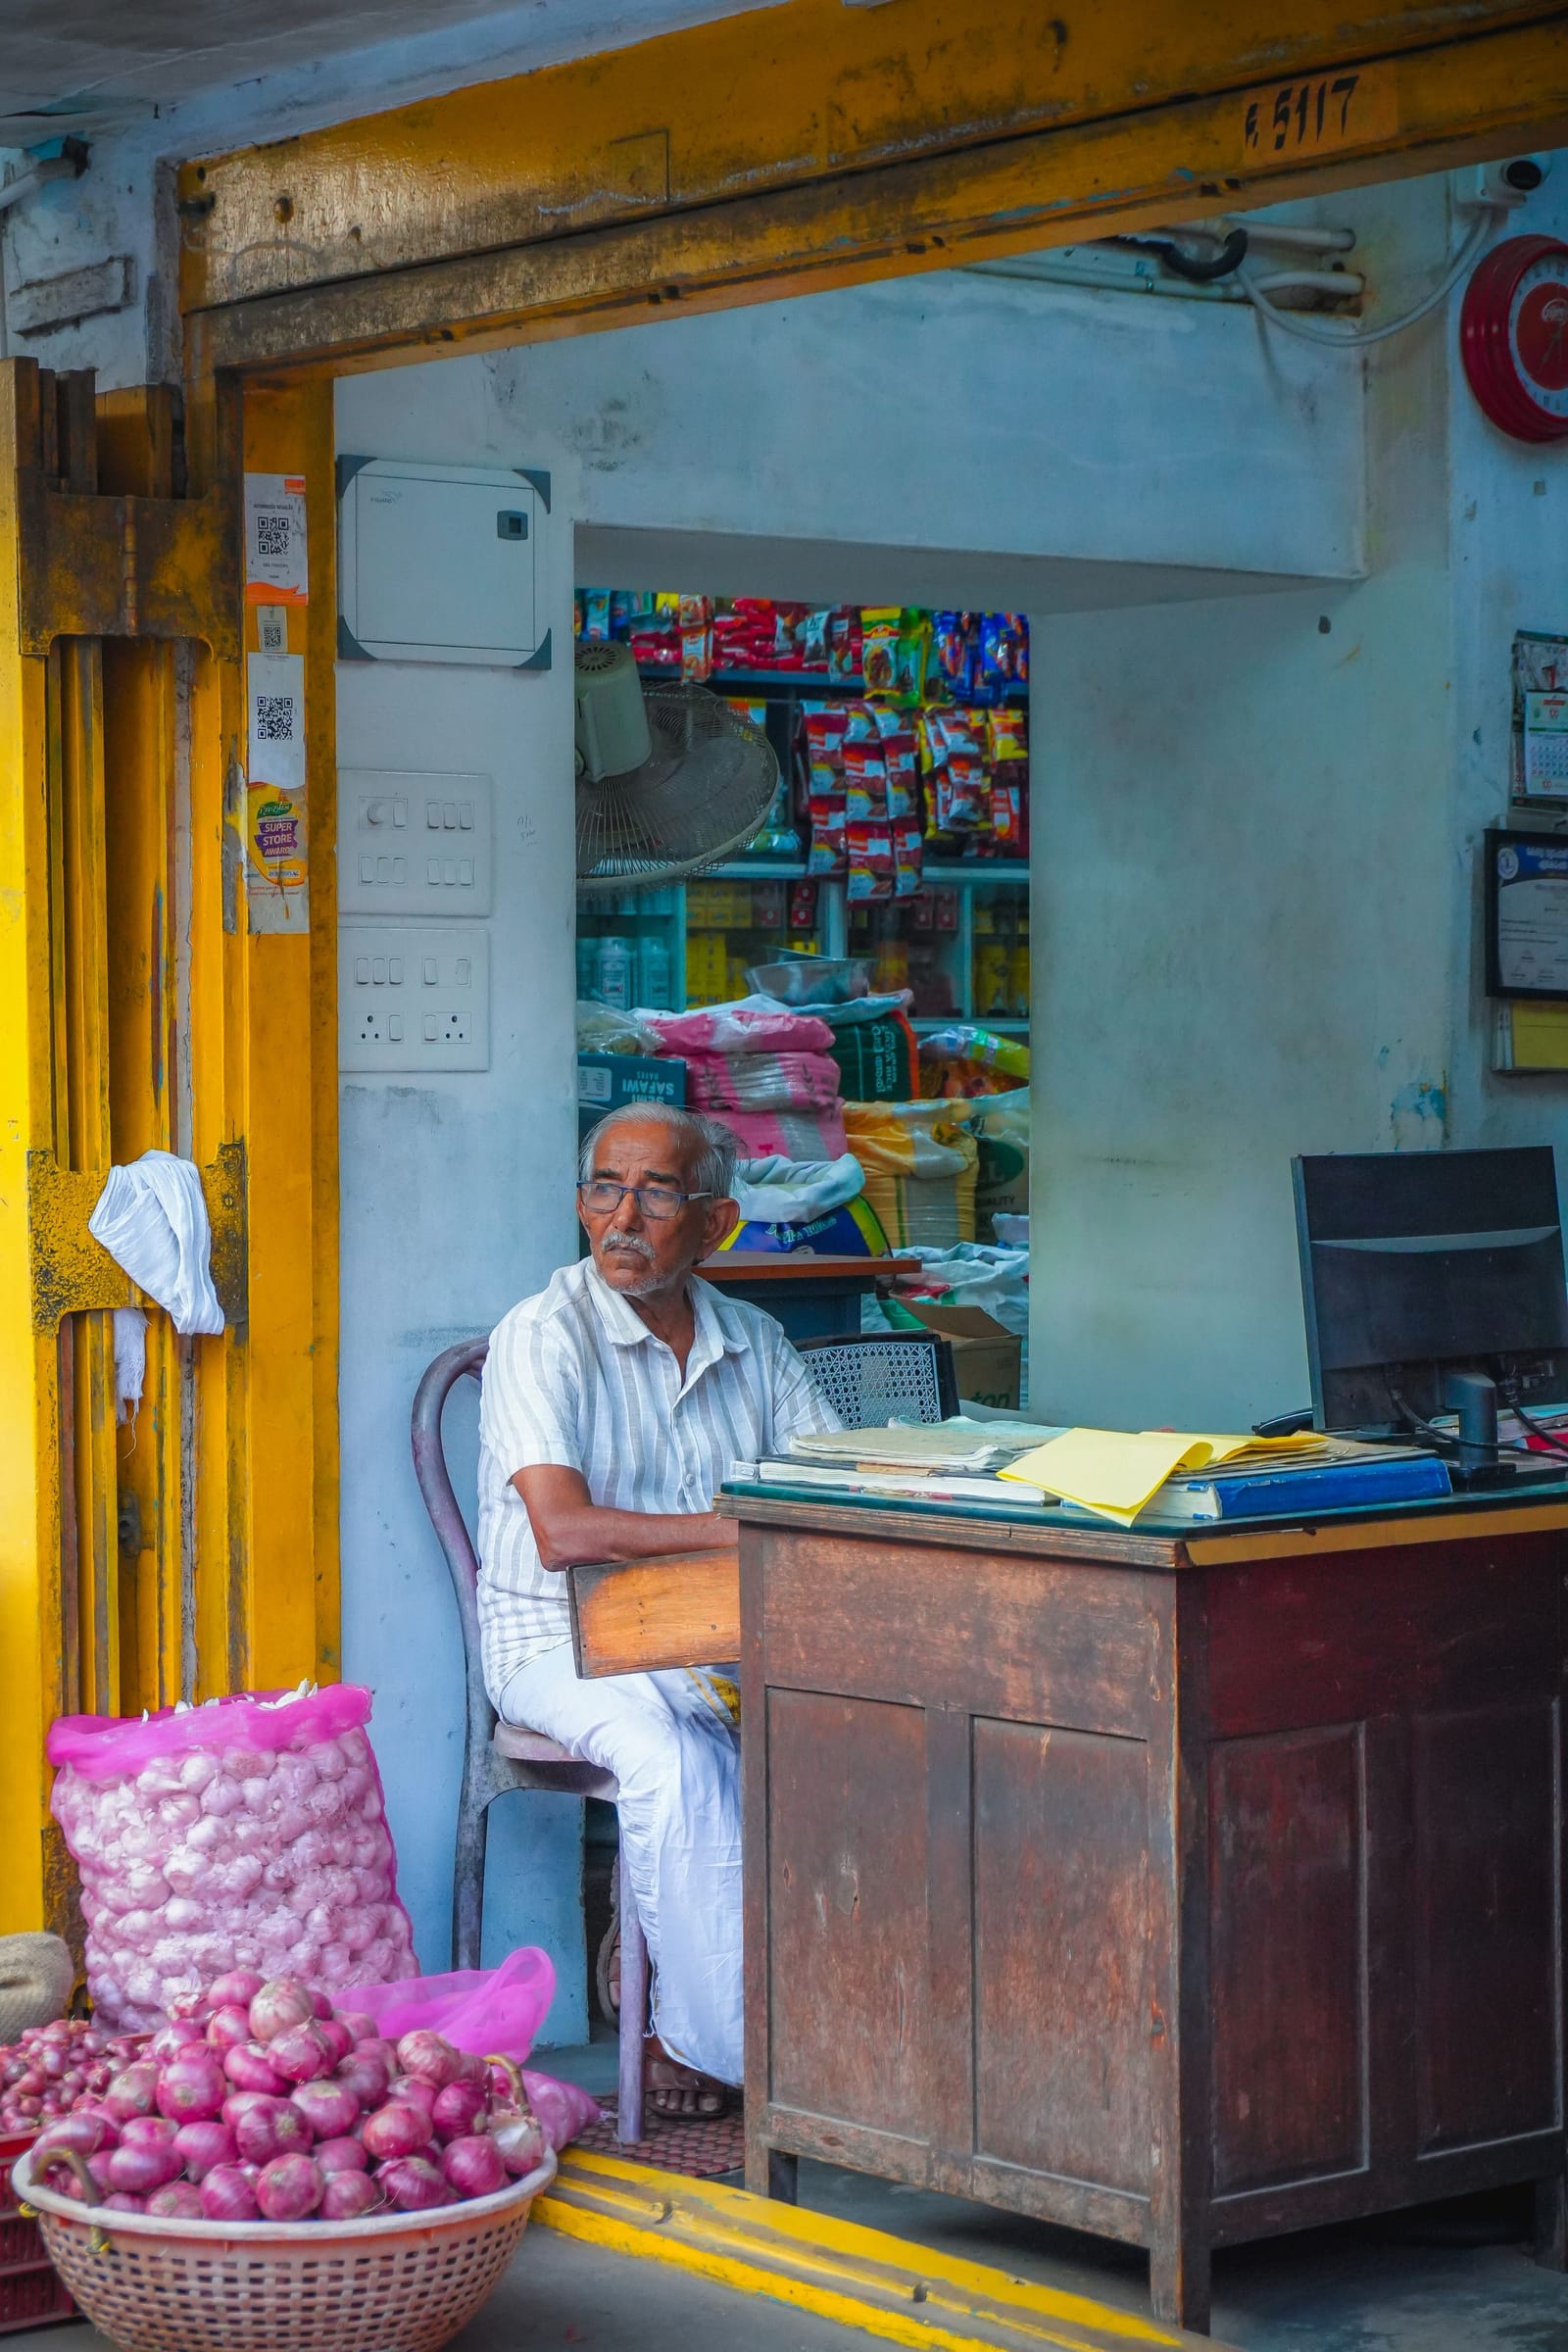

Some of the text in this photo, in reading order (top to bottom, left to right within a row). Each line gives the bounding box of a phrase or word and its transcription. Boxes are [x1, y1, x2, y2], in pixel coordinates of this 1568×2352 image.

[265, 822, 293, 832] SUPER
[263, 834, 293, 846] STORE
[622, 1078, 675, 1096] SAFAWI
